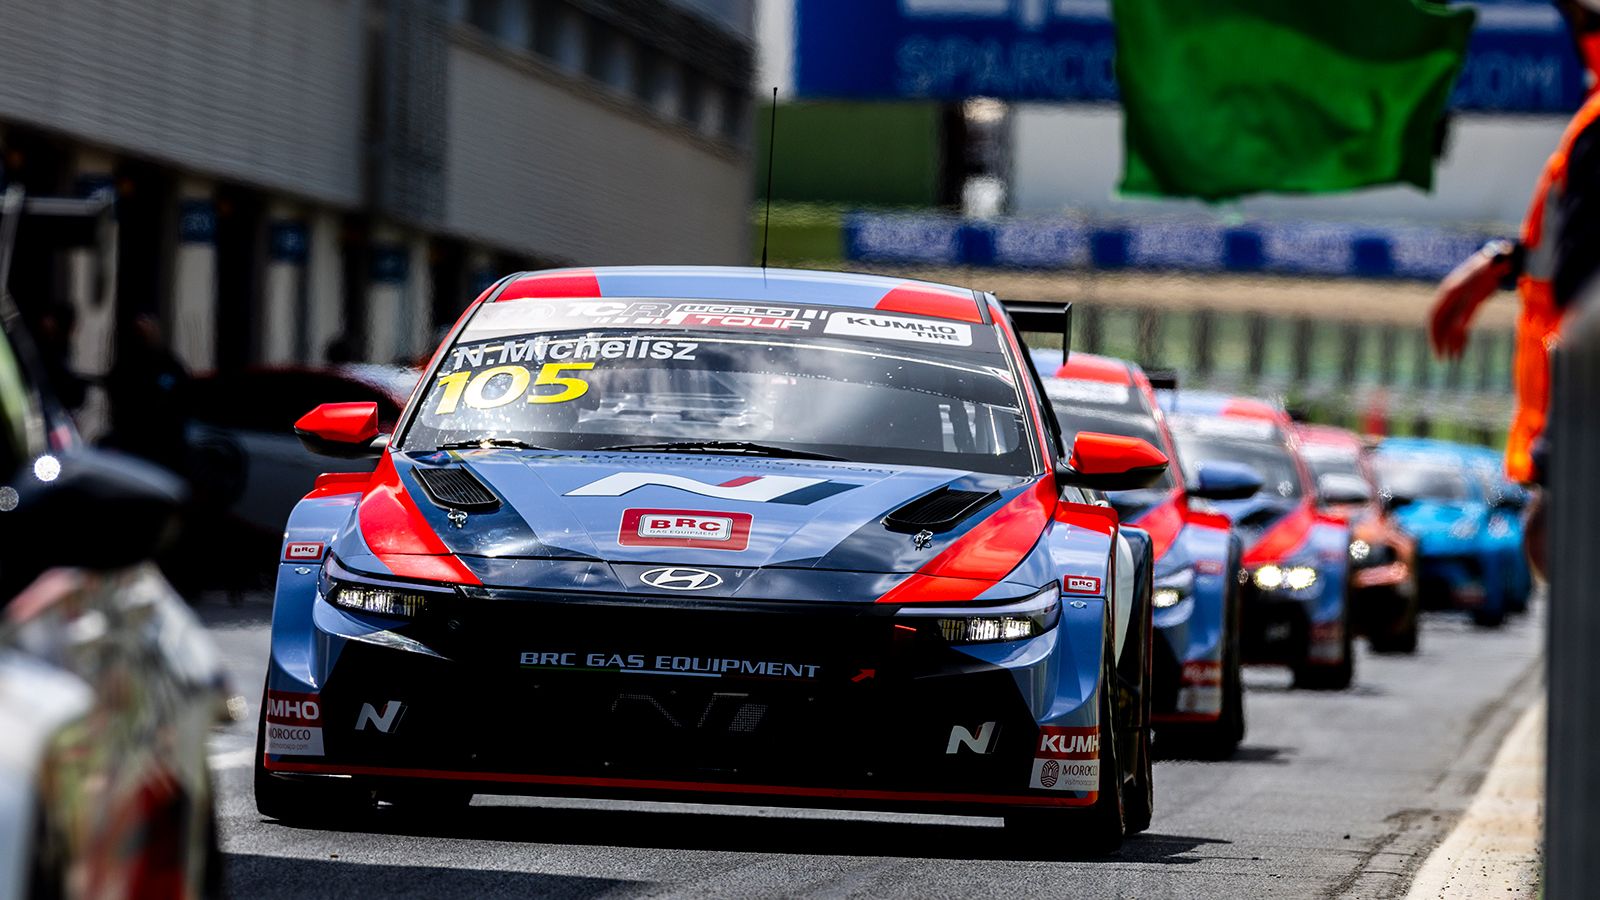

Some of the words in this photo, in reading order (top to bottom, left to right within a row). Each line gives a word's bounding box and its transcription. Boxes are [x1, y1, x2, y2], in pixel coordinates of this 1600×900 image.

[565, 302, 672, 318] TCR
[683, 304, 787, 317] WORLD
[693, 314, 812, 330] TOUR
[847, 317, 957, 335] KUMHO
[911, 330, 960, 342] TIRE
[454, 335, 699, 370] N.Michelisz
[435, 362, 595, 415] 105
[650, 518, 721, 531] BRC
[1071, 580, 1093, 588] BRC
[520, 652, 576, 666] BRC
[586, 653, 645, 668] GAS
[655, 655, 820, 678] EQUIPMENT
